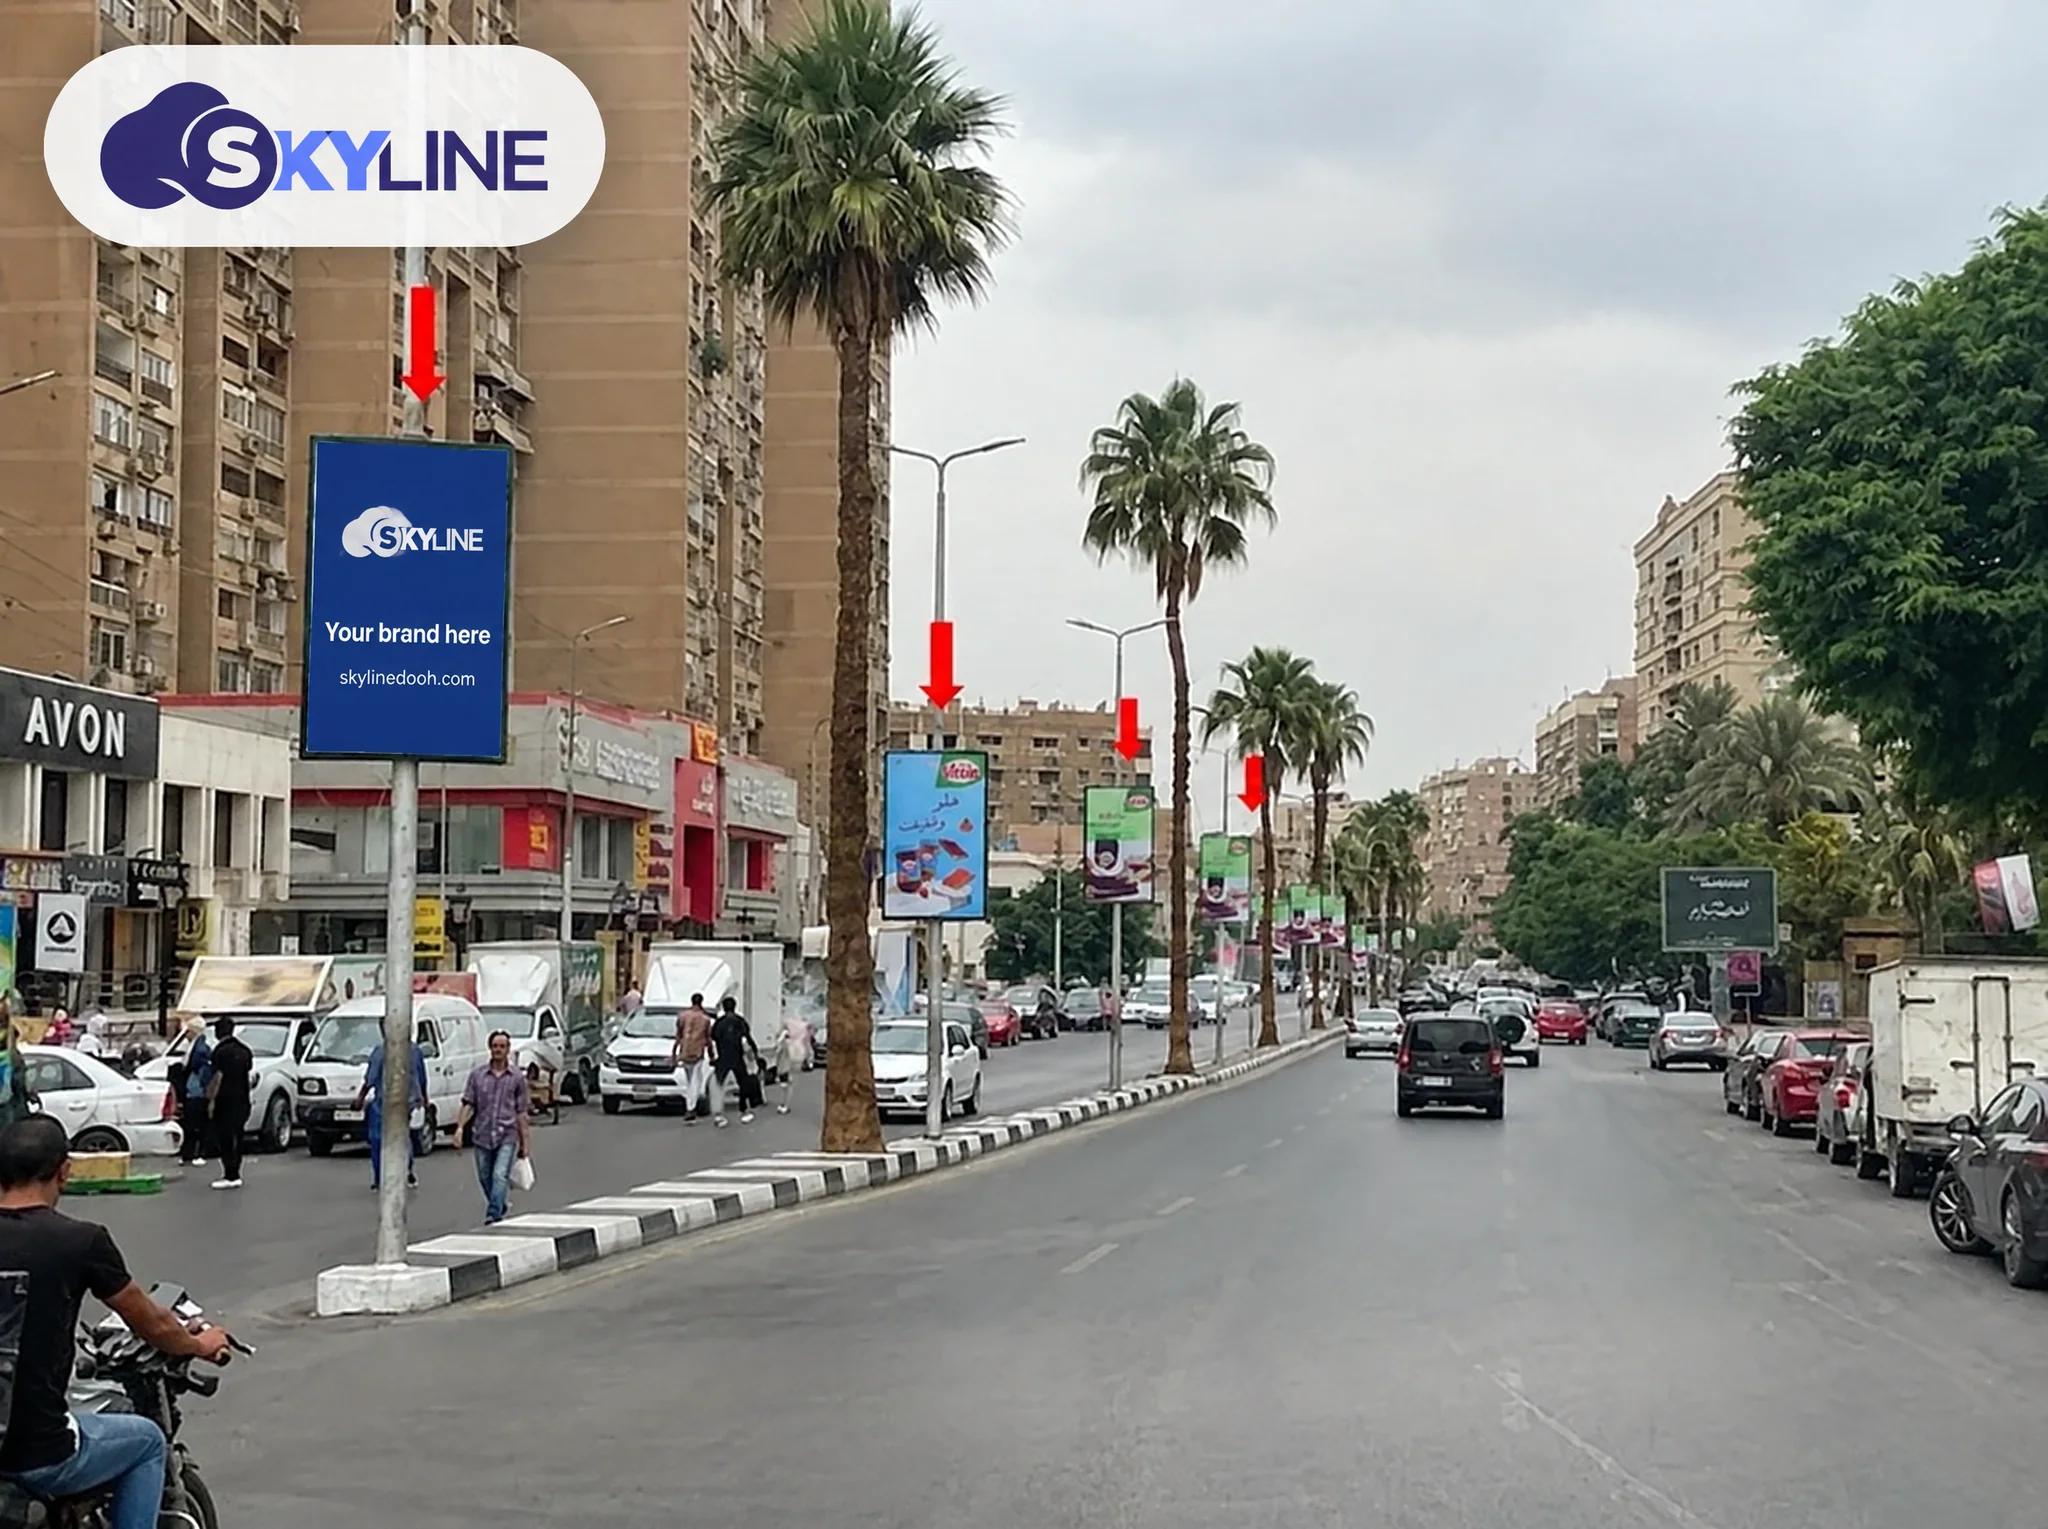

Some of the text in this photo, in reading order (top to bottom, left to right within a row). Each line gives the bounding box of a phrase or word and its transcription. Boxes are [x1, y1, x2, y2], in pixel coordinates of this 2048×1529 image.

[379, 525, 484, 552] SKYLINE
[324, 621, 491, 645] Your brand here
[339, 669, 476, 689] skylinedooh.com
[24, 695, 126, 758] AVON
